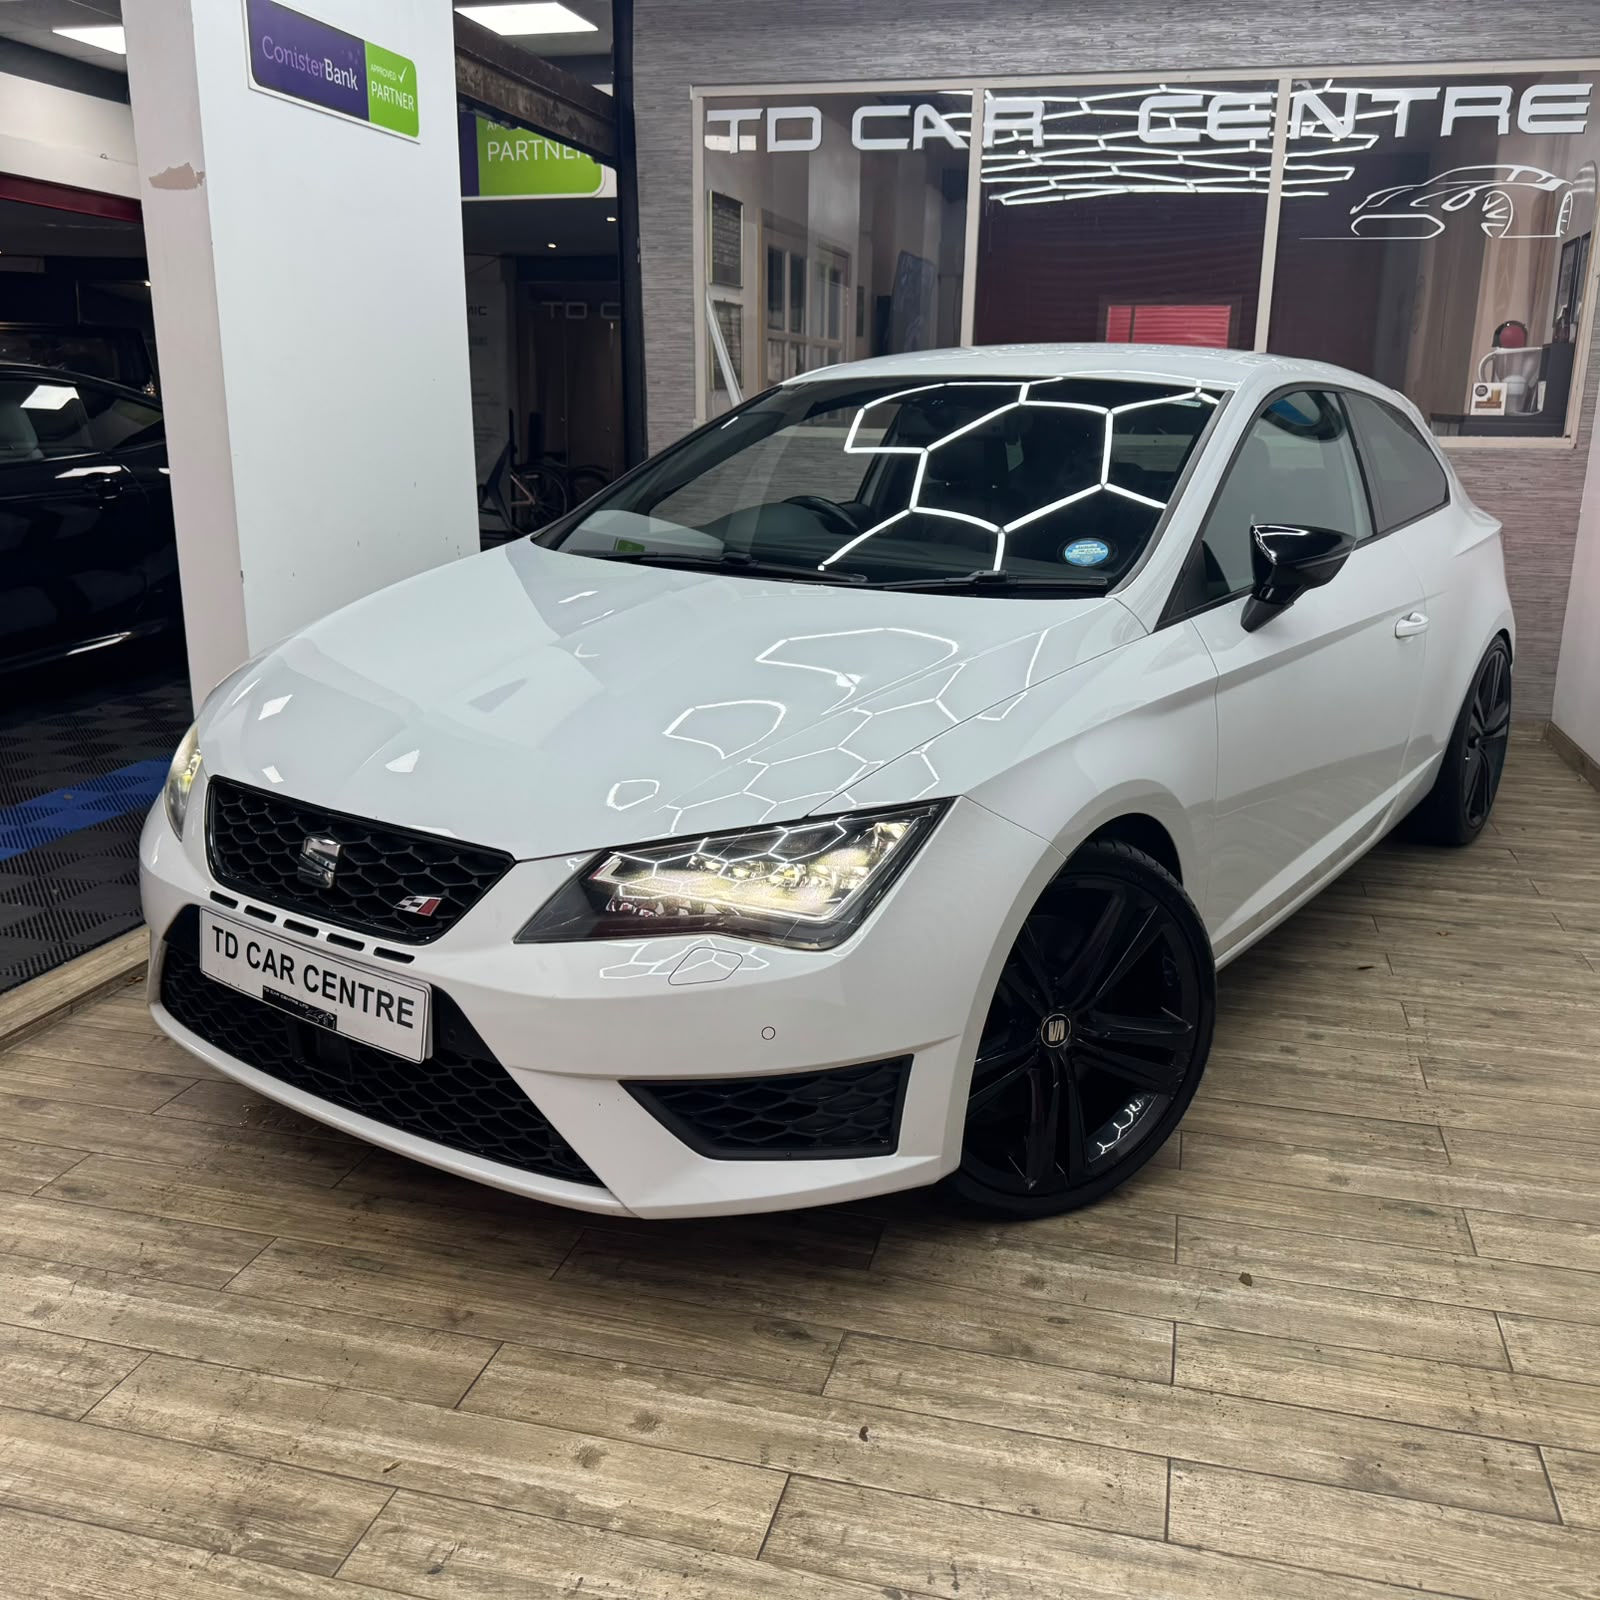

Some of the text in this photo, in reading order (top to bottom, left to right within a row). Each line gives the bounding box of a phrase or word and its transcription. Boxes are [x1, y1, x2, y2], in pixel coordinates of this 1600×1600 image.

[261, 35, 359, 91] ConisterBank
[370, 63, 397, 81] APPROVED
[371, 80, 415, 112] PARTNER
[706, 82, 1593, 154] TD CAR CENTRE
[212, 925, 415, 1029] TD CAR CENTRE
